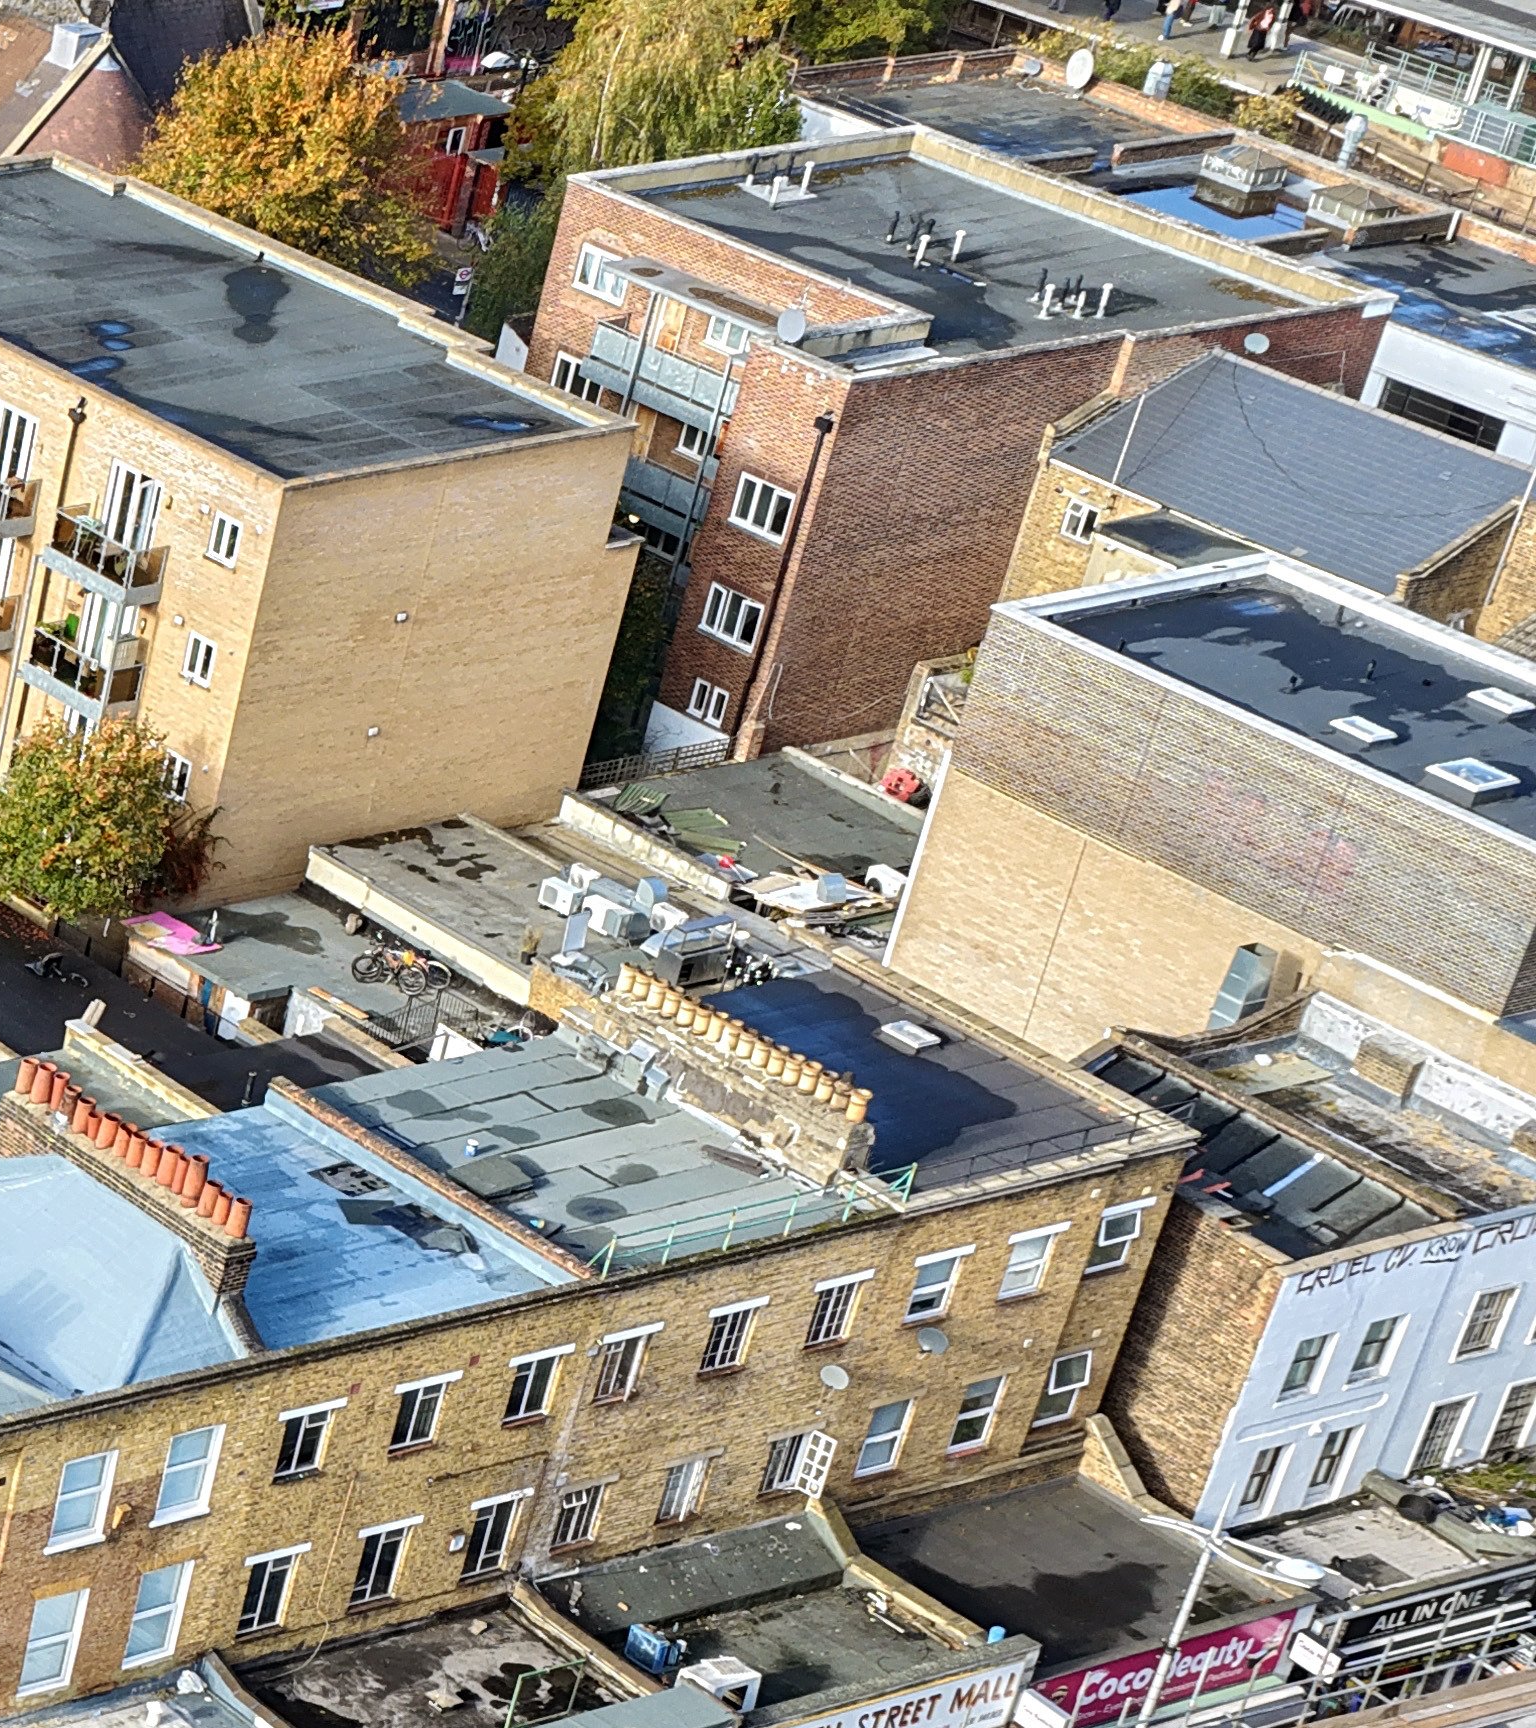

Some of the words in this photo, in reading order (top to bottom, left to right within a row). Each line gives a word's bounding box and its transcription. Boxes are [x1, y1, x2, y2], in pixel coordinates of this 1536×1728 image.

[1370, 1609, 1408, 1634] ALL
[1411, 1601, 1436, 1623] IN
[1439, 1588, 1486, 1617] ONE
[949, 1672, 1017, 1714] MALL
